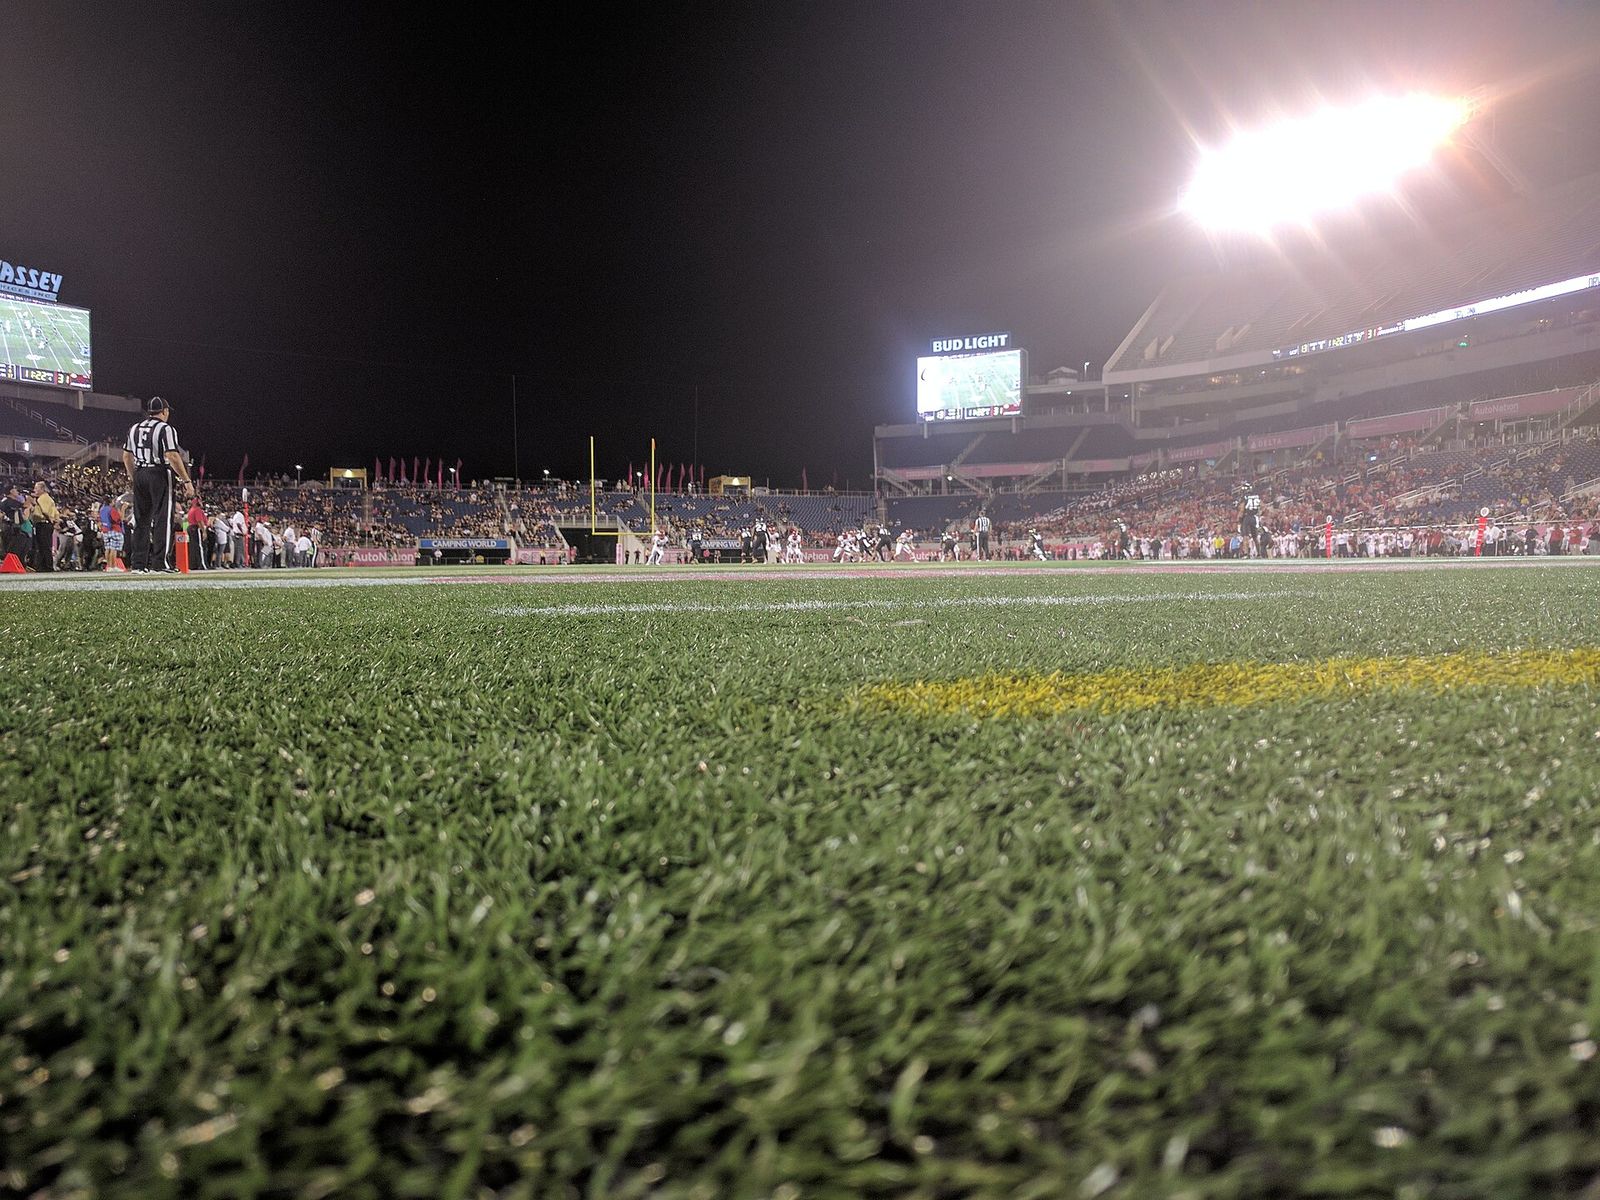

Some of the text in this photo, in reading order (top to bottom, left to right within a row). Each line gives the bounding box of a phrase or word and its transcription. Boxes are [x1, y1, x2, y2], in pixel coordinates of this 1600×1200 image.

[0, 260, 63, 292] ASSEY
[932, 334, 1008, 352] BUD LIGHT
[1257, 438, 1281, 449] DELTA
[432, 540, 497, 548] CAMPING WORLD
[700, 540, 728, 549] AMPING
